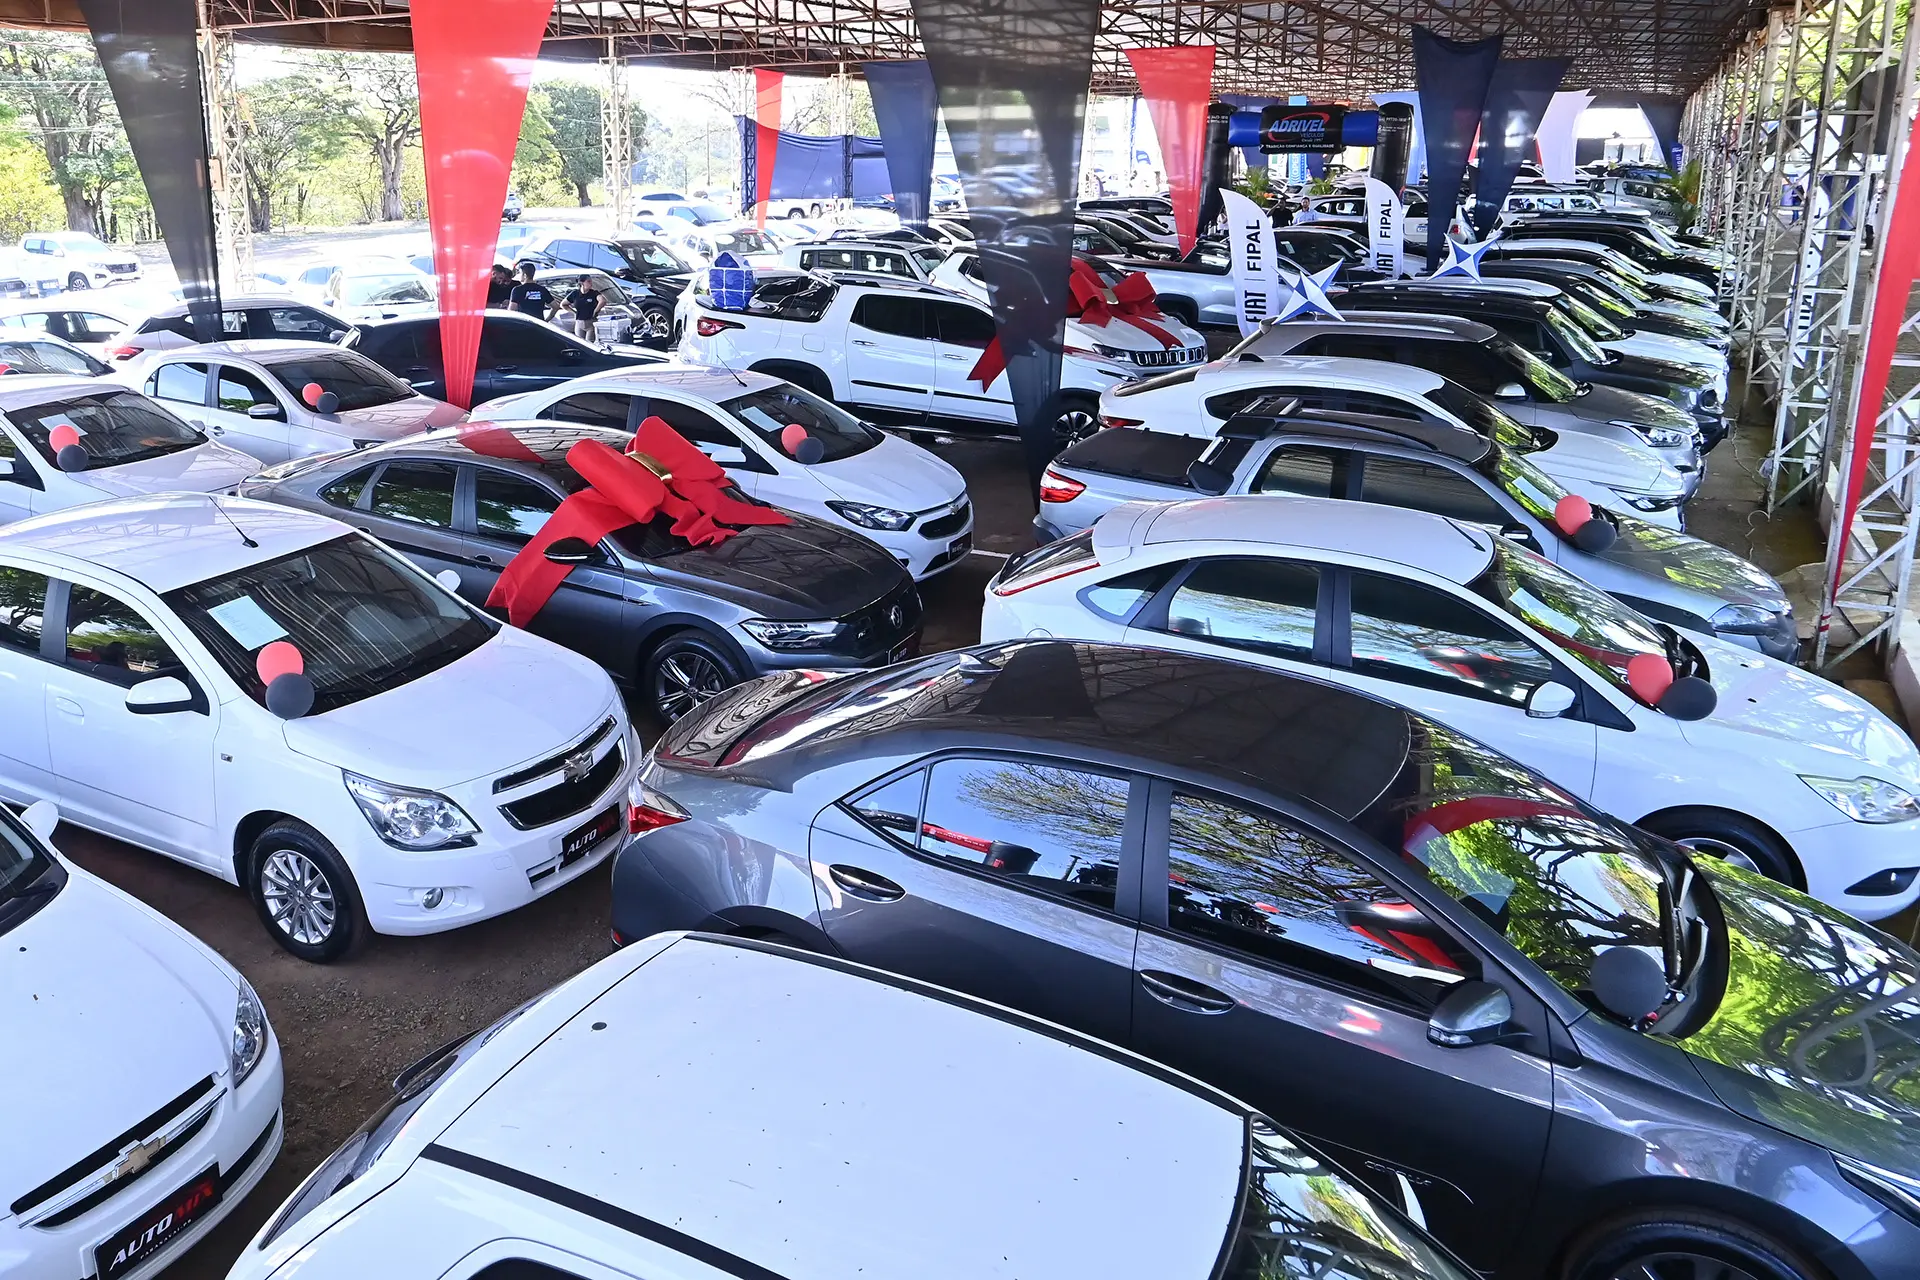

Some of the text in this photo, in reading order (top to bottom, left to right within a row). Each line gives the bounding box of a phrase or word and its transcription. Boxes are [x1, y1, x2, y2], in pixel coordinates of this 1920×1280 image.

[1268, 119, 1325, 132] ADRIVEL
[1379, 199, 1392, 239] FIPAL
[1244, 219, 1267, 323] FIAT FIPAL
[567, 828, 597, 856] AUTO
[109, 1212, 174, 1272] AUTO
